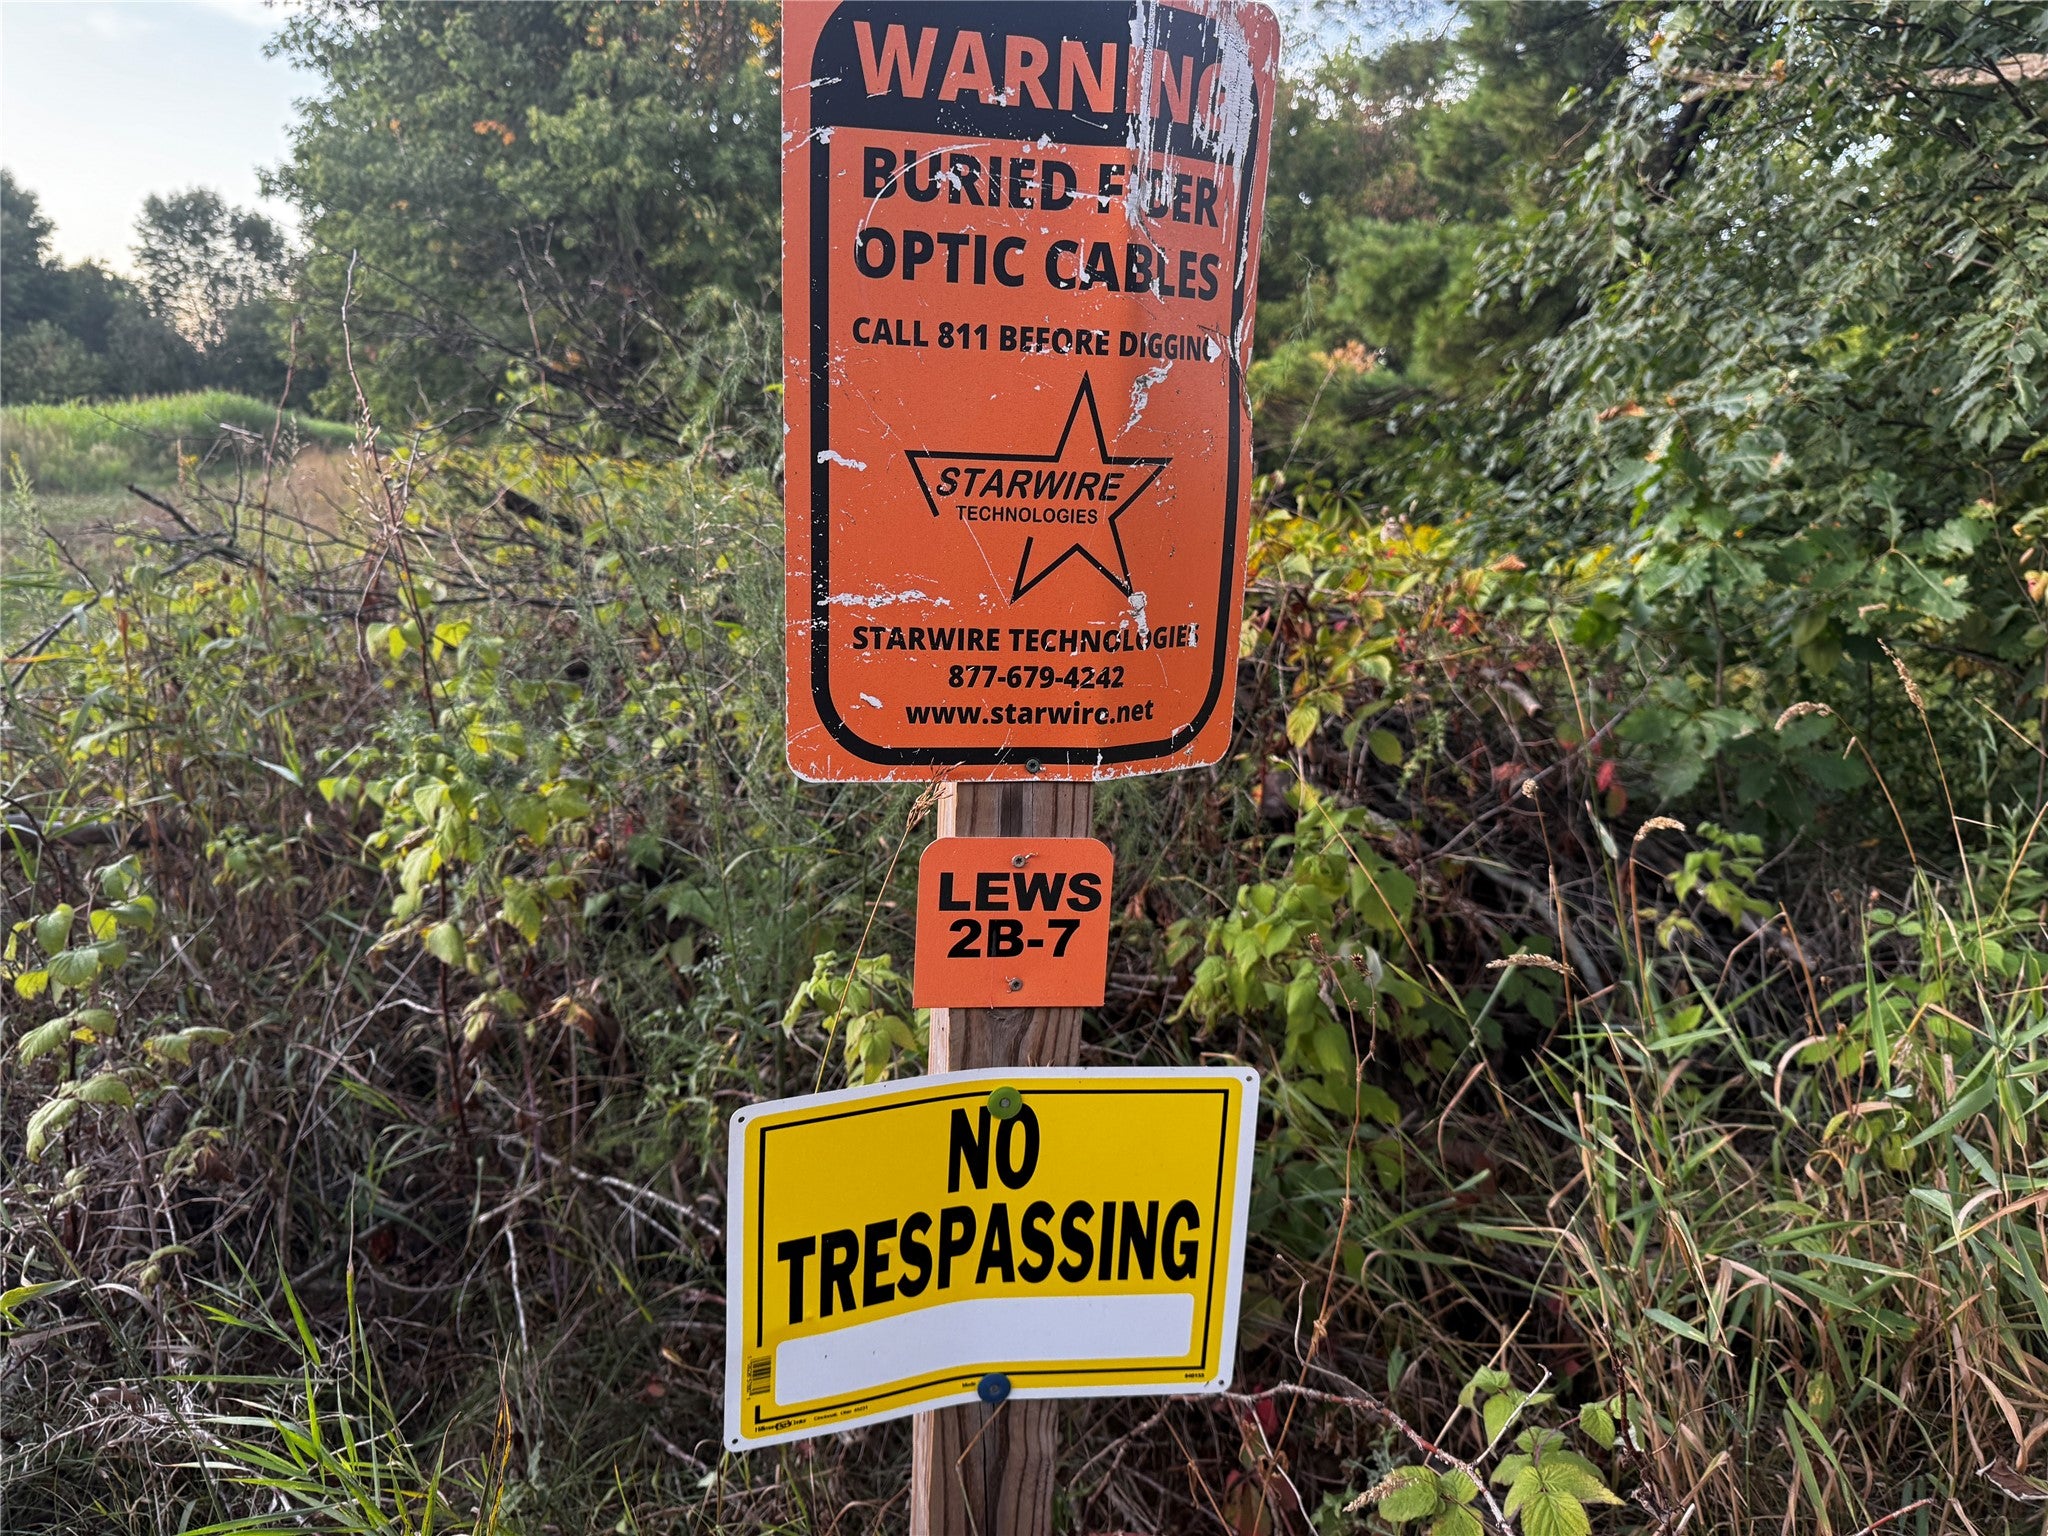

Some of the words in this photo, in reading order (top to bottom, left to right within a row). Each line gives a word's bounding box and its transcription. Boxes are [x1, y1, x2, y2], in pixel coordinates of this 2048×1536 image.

[863, 147, 1077, 211] BURIED
[1097, 163, 1219, 228] FBER
[854, 227, 1027, 288] OPTIC
[1045, 238, 1220, 301] CABLES
[852, 317, 929, 348] CALL
[938, 322, 988, 351] 811
[1000, 325, 1109, 357] BEFORE
[936, 466, 1126, 502] STARWIRE
[957, 505, 1098, 525] TECHNOLOGIES
[852, 625, 1011, 652] STARWIRE
[949, 664, 1125, 689] 877-679-4242
[906, 699, 1154, 725] www.starwire.net
[938, 872, 1102, 912] LEWS
[947, 918, 1081, 958] 2B-7
[947, 1101, 1040, 1193] NO
[777, 1199, 1200, 1325] TRESPASSING
